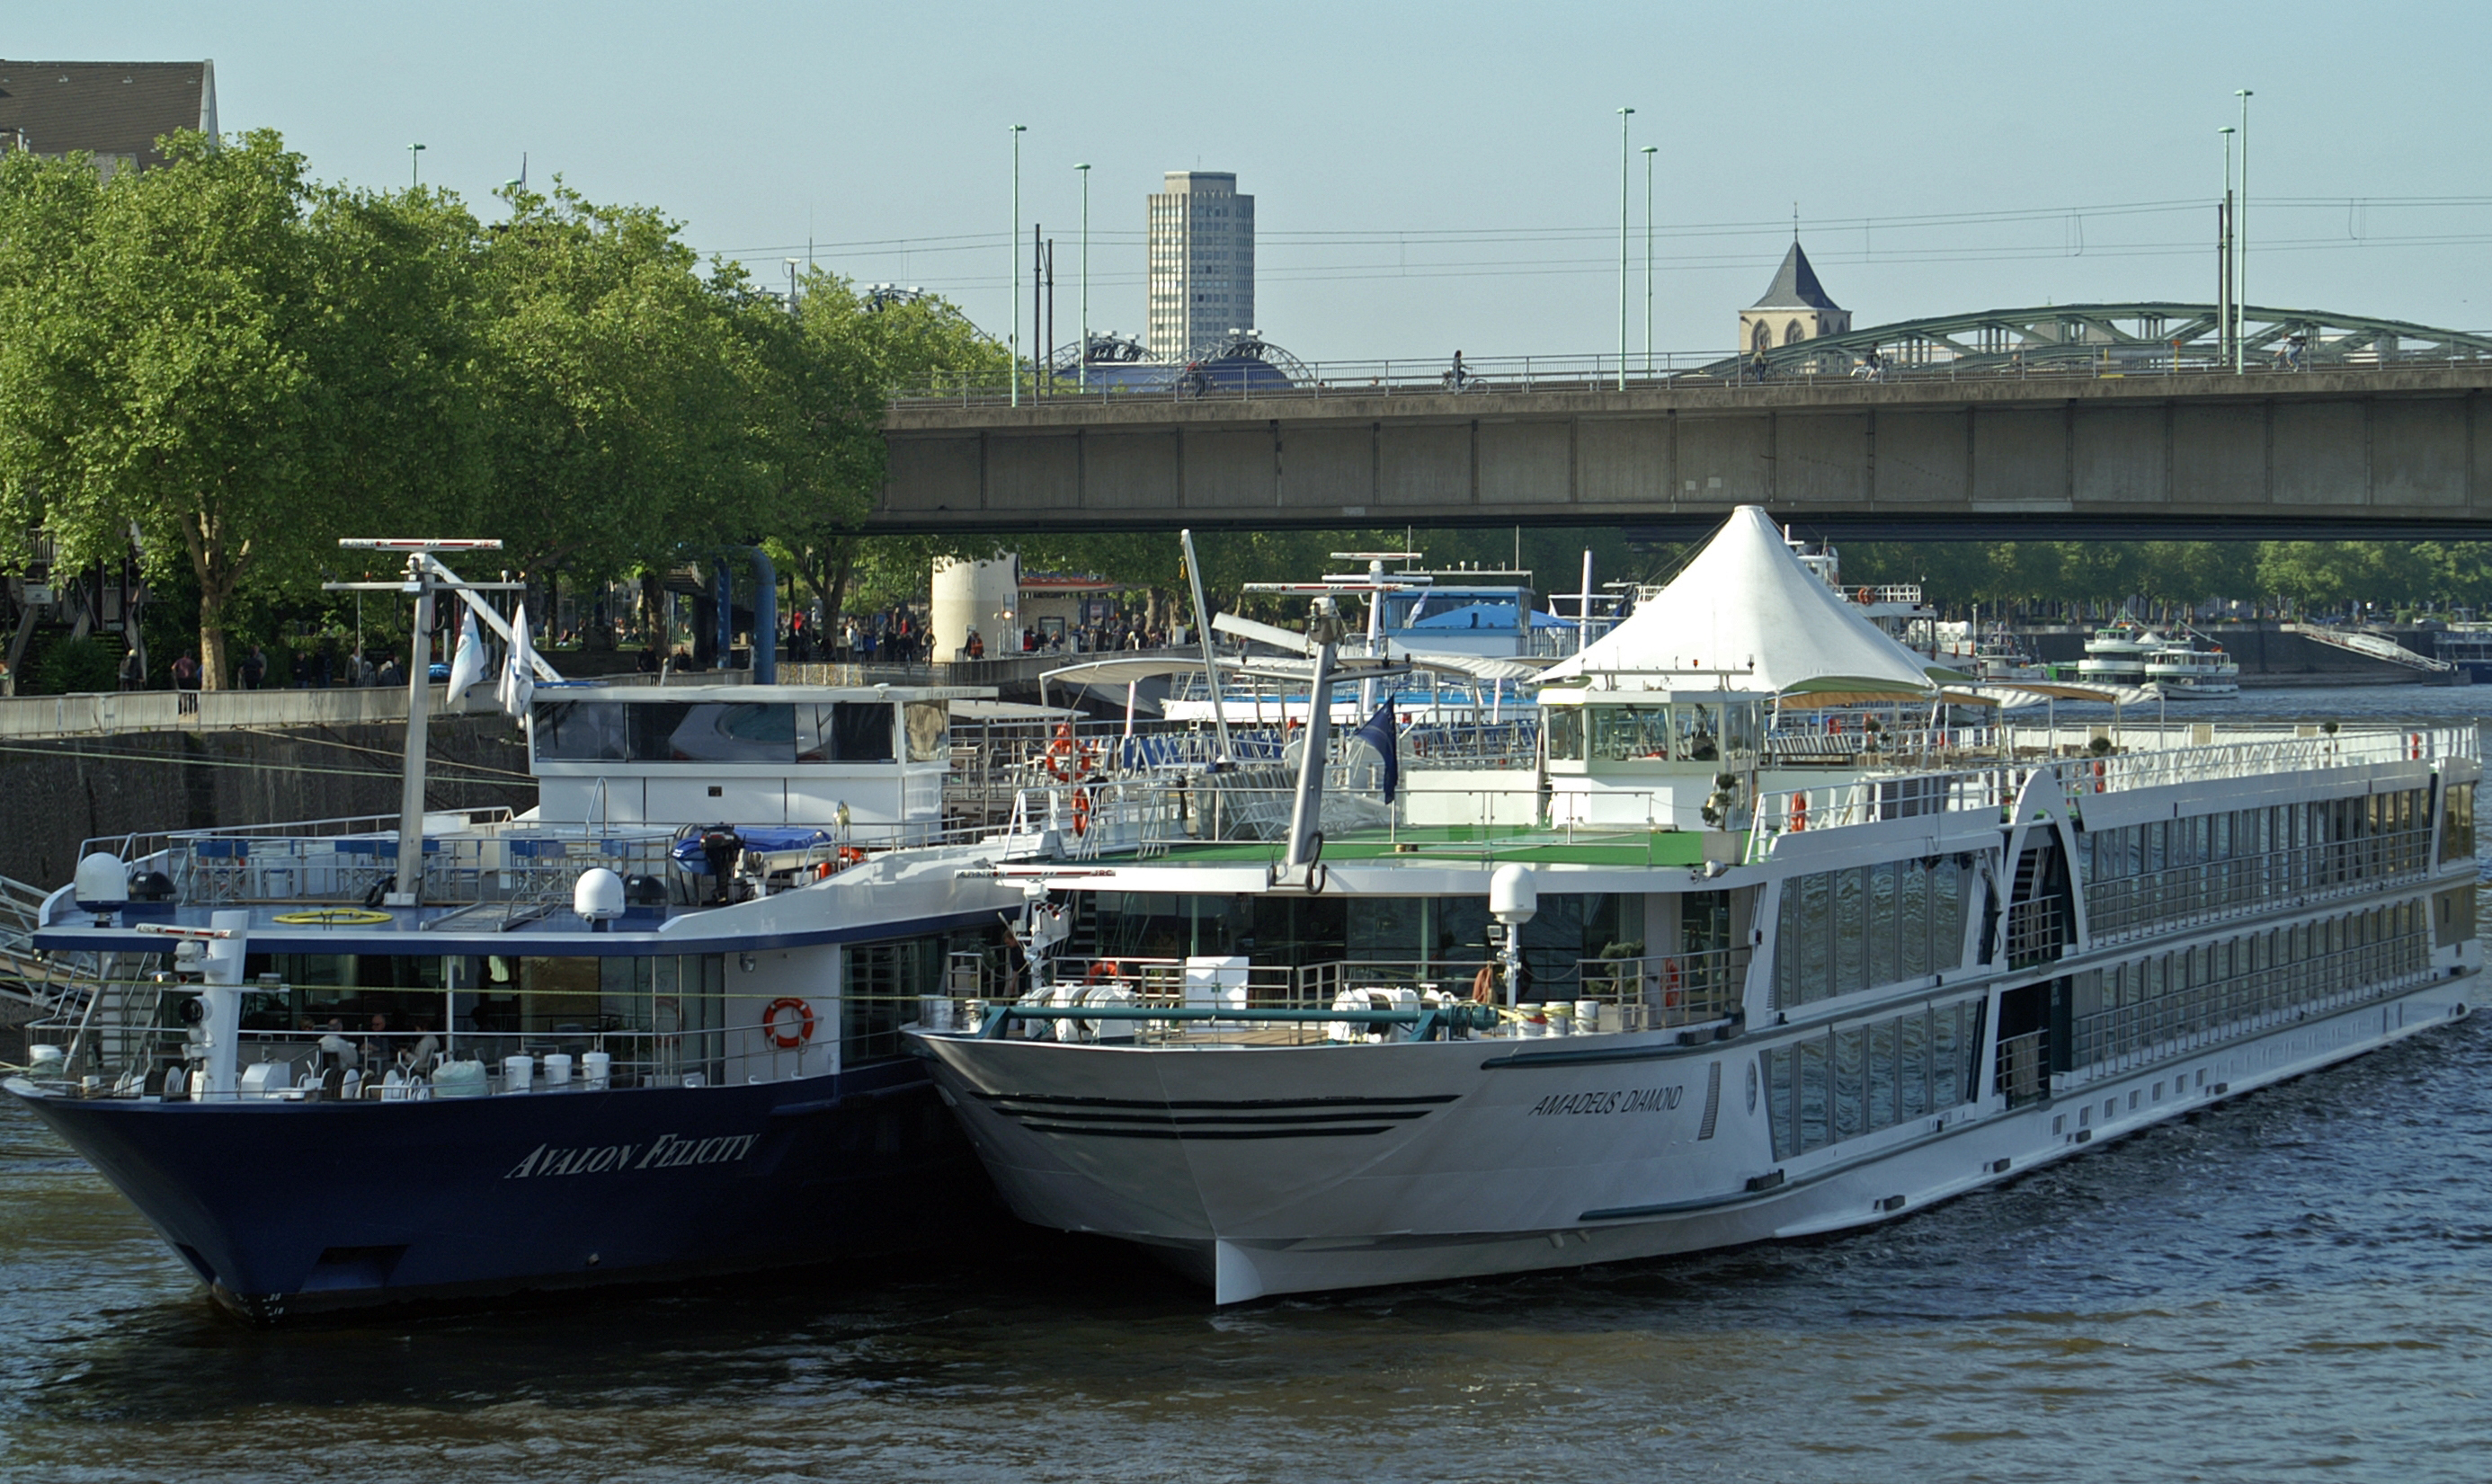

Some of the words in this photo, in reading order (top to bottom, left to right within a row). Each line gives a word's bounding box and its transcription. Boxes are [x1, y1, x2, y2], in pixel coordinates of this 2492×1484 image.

[1528, 1090, 1622, 1115] AMADEUS
[1620, 1085, 1684, 1113] DIAMOND
[503, 1142, 642, 1178] AVALON
[633, 1133, 761, 1169] FELICITY
